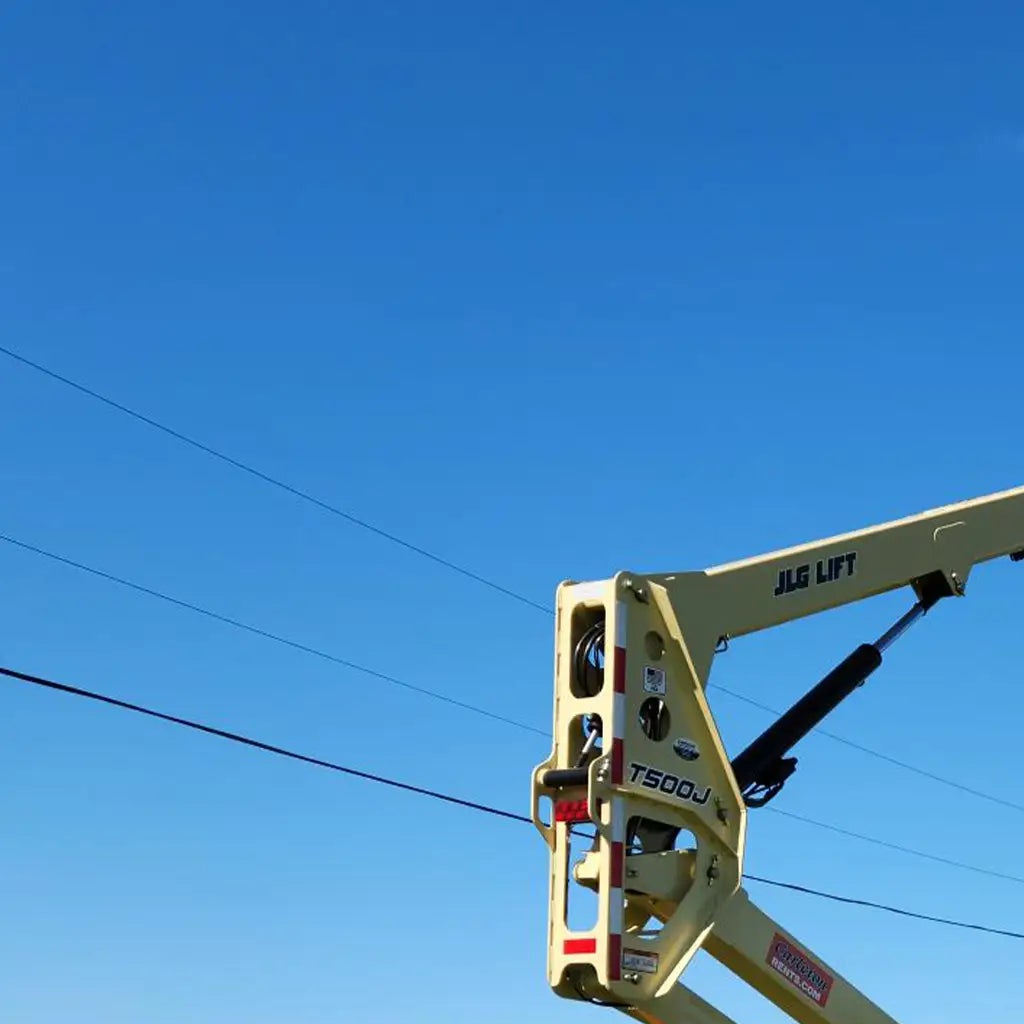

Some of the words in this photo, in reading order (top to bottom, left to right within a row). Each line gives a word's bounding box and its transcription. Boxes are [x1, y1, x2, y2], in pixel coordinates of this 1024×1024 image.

[774, 564, 810, 596] JLG
[816, 551, 857, 584] LIFT
[630, 763, 711, 804] T500J
